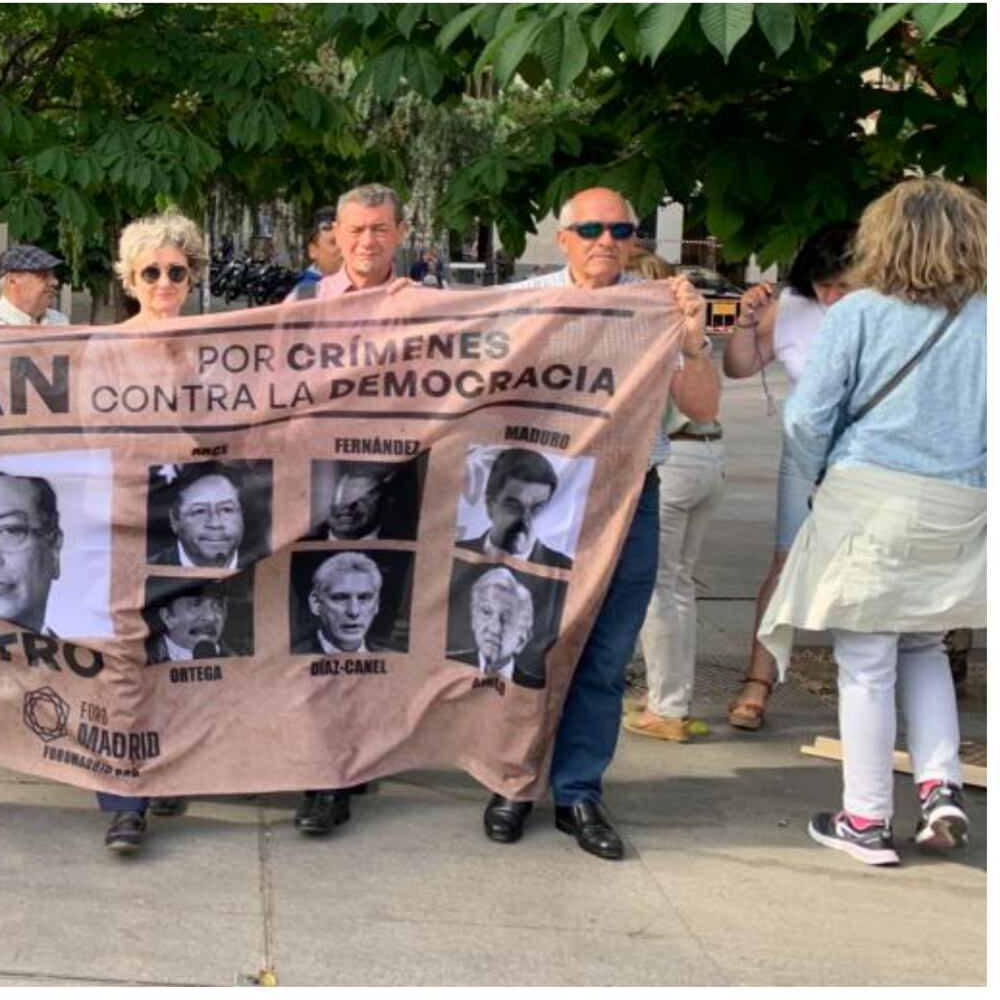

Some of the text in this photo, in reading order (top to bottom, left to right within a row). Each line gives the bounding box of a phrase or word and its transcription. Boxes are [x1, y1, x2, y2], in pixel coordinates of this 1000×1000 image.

[200, 331, 511, 375] POR CRÍMENES
[92, 363, 617, 413] CONTRA LA DEMOCRACIA
[334, 436, 422, 455] FERNÁNDEZ
[504, 425, 571, 450] MADURO
[169, 665, 223, 684] ORTEGA
[310, 656, 387, 676] DÍAZ-CANEL
[77, 722, 161, 761] MADRID
